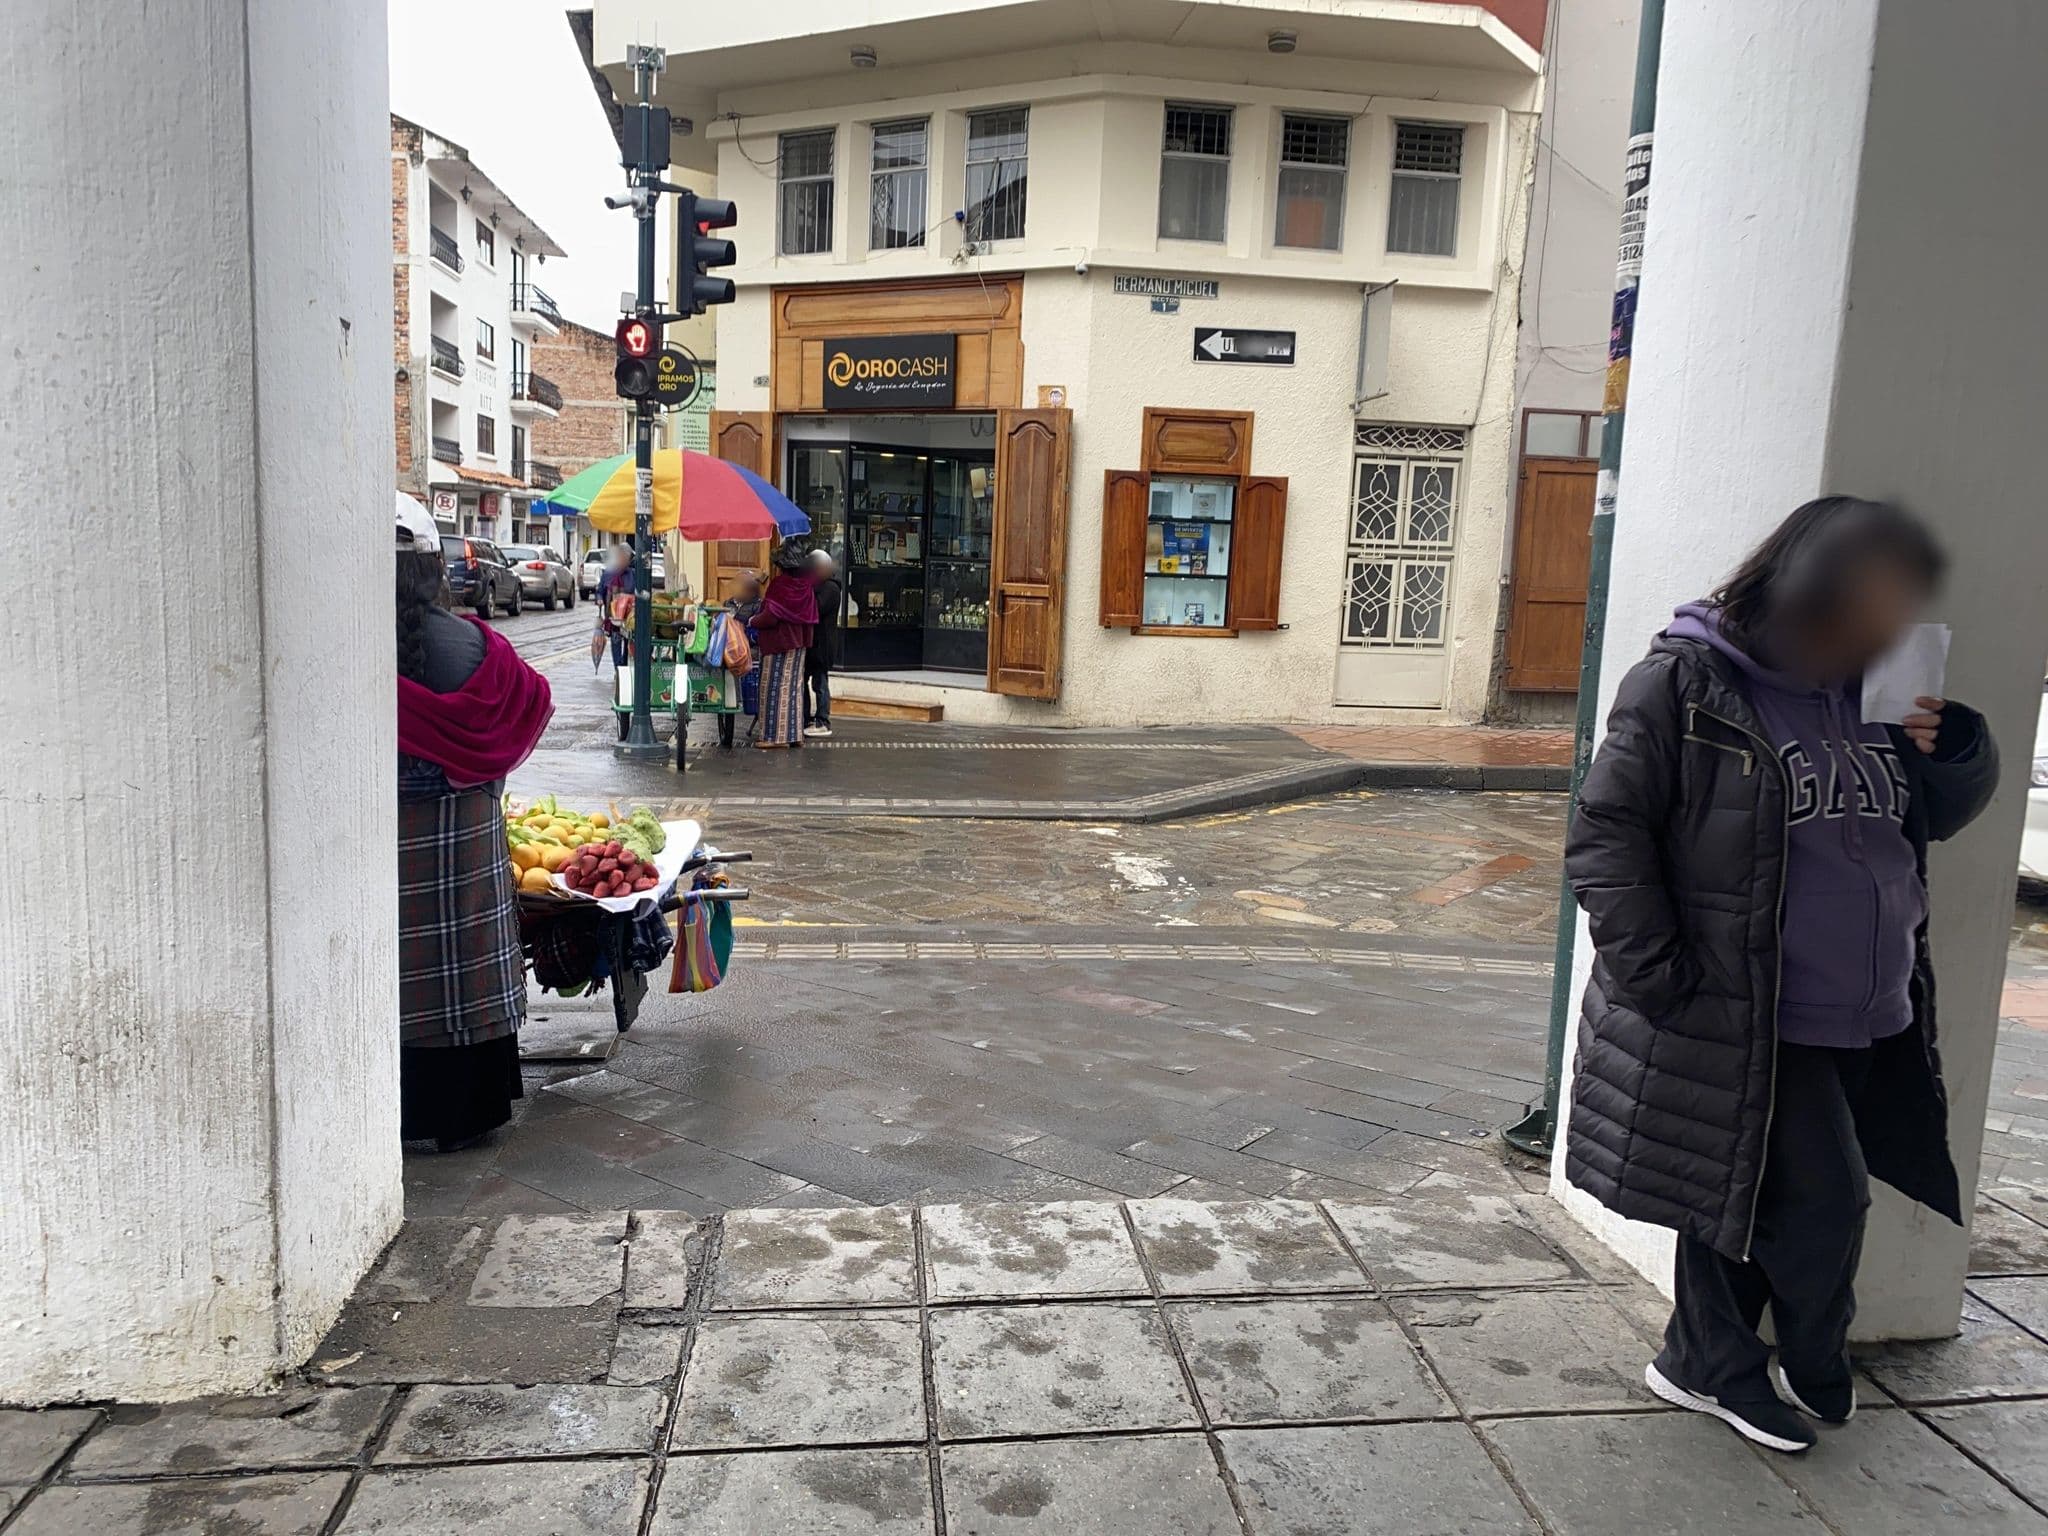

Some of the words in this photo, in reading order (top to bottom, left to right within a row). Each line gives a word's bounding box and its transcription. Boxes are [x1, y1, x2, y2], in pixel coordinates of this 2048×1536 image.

[1115, 277, 1170, 293] HERMANO
[1174, 280, 1215, 297] MIGUEL
[856, 356, 947, 377] OROCASH
[658, 383, 677, 391] ORO
